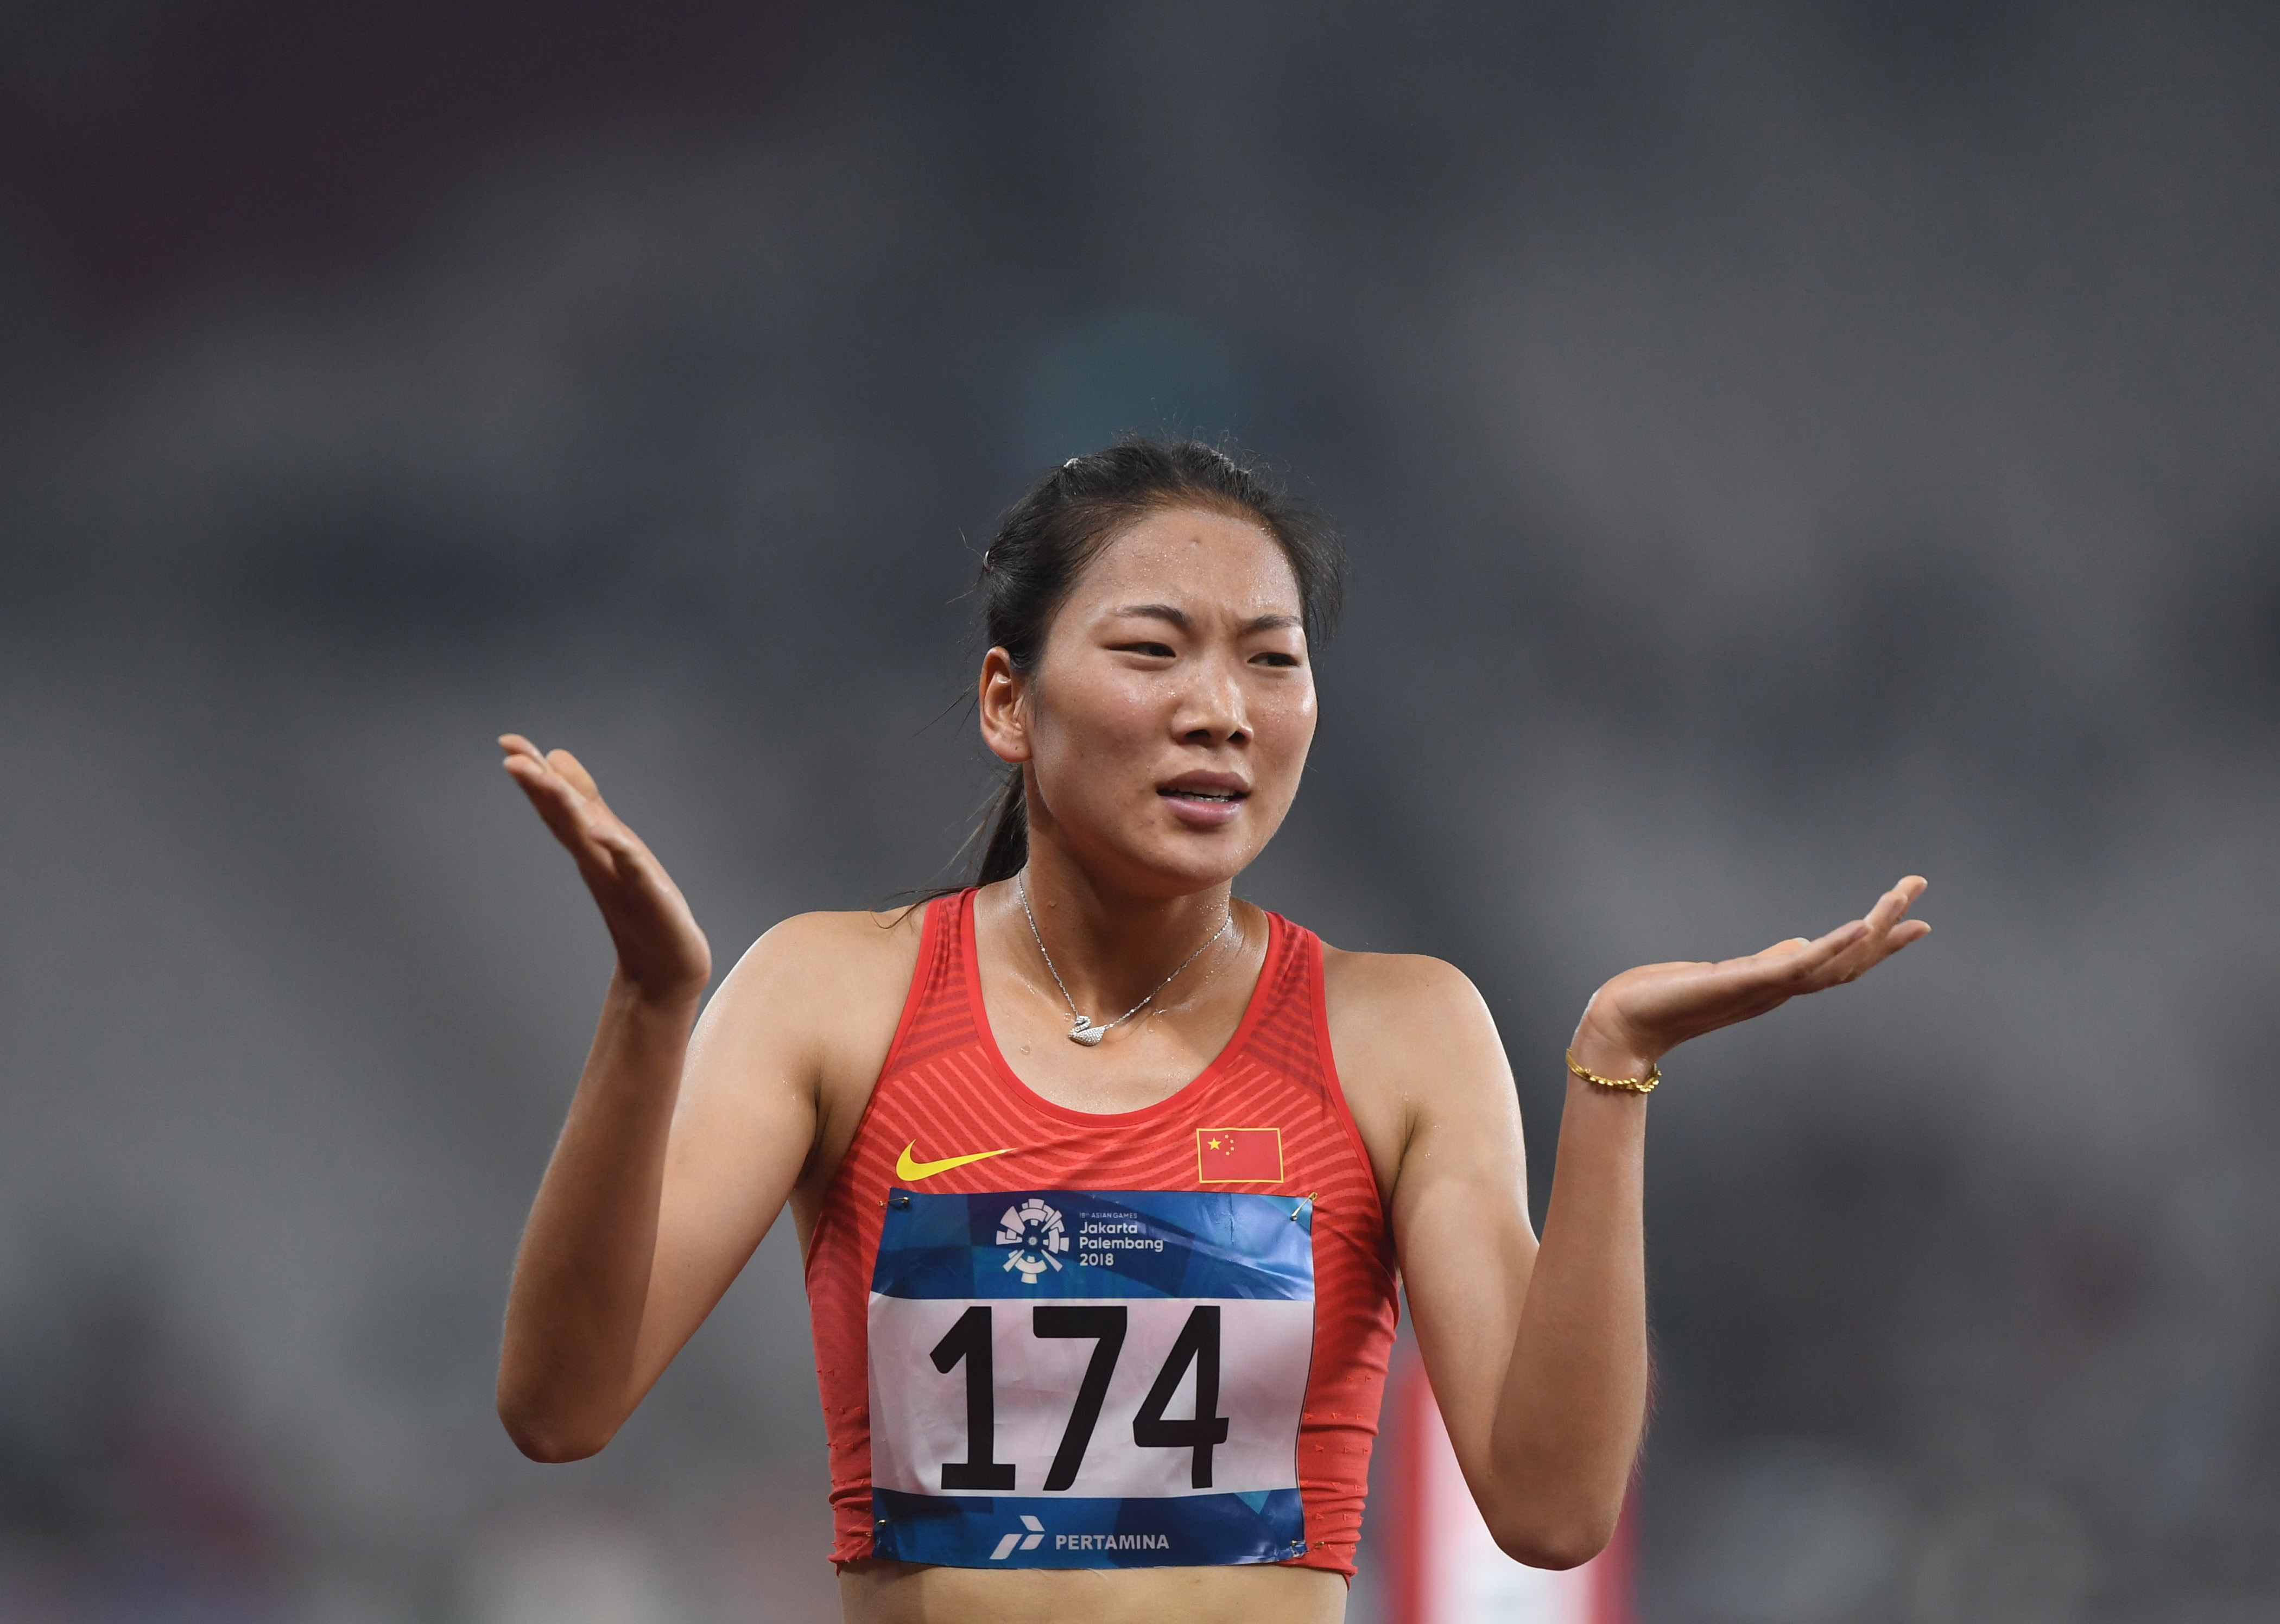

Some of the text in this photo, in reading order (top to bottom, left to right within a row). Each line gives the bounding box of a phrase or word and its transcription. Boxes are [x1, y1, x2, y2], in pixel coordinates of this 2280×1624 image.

[1079, 1222, 1137, 1234] Jakarta
[1079, 1237, 1163, 1252] Palembang
[1080, 1253, 1114, 1266] 2018
[929, 1305, 1229, 1490] 174
[1055, 1534, 1169, 1550] PERTAMINA
